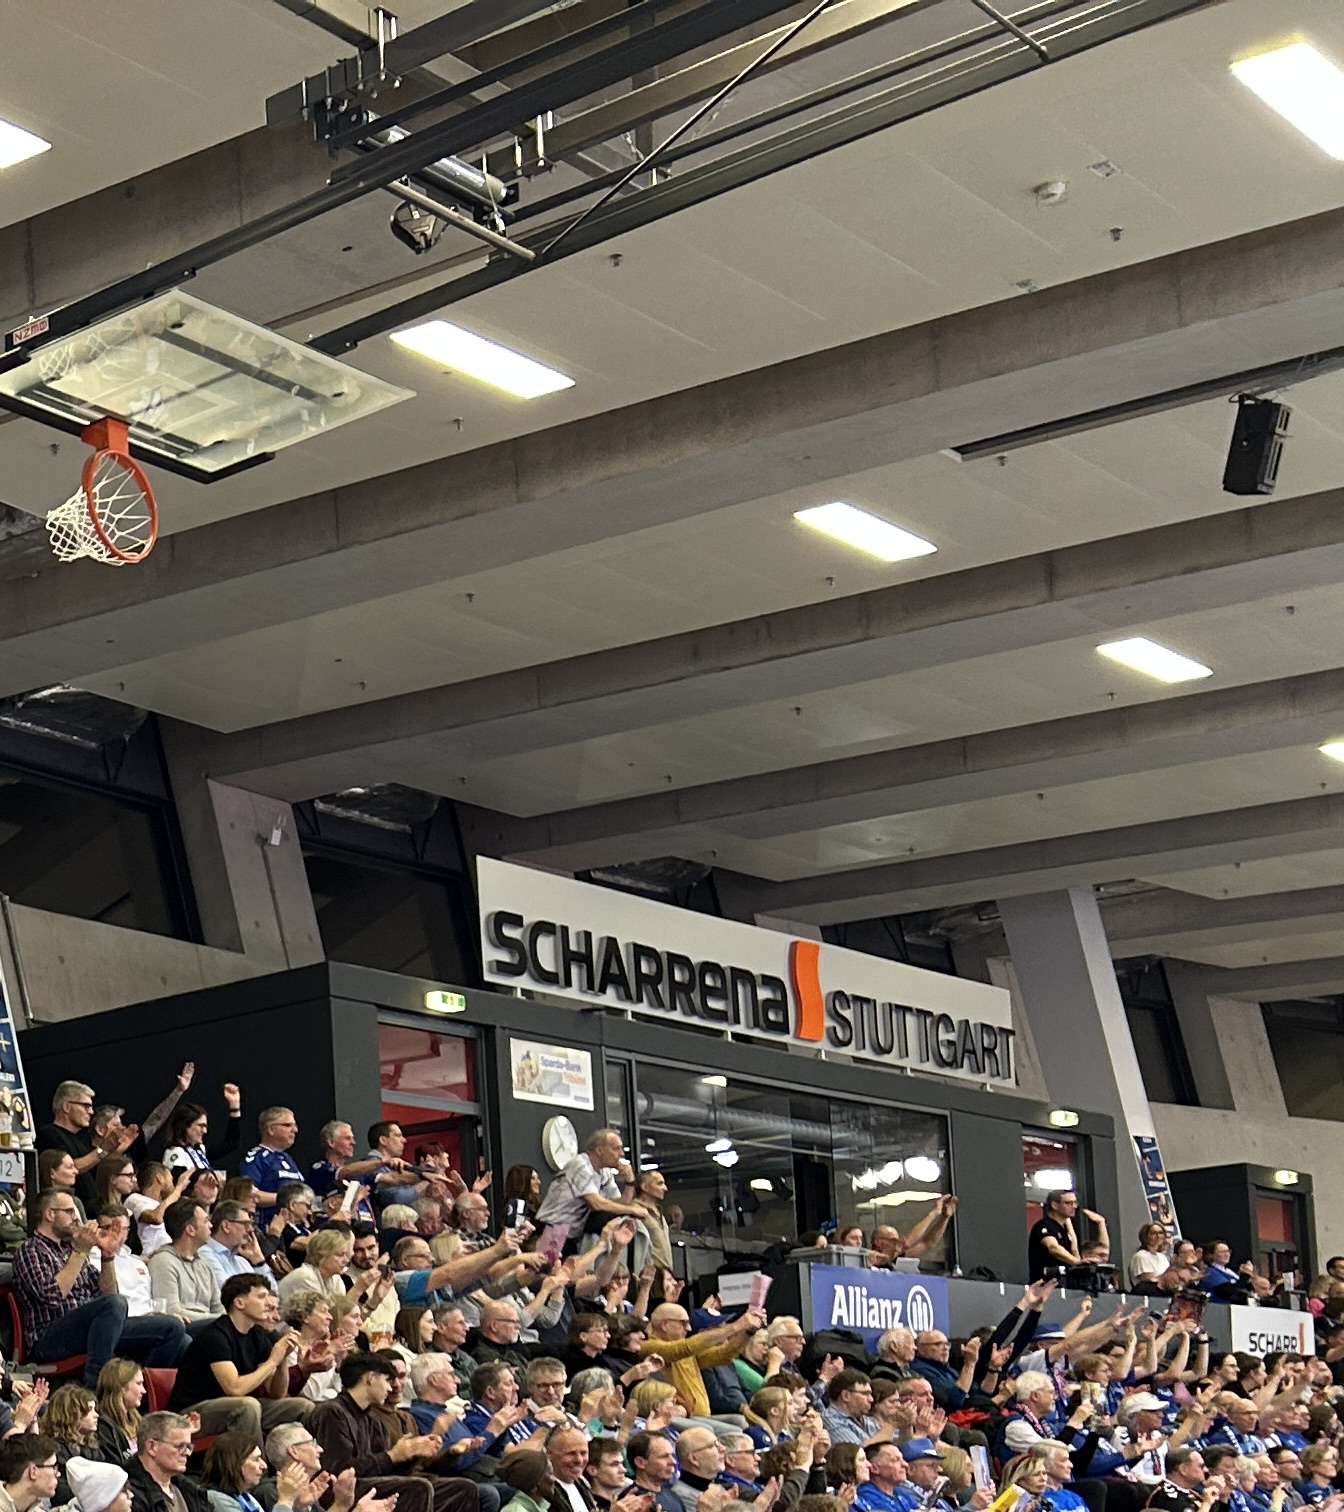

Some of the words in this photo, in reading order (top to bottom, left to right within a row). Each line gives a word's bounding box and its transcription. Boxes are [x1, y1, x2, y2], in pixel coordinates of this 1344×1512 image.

[826, 990, 1016, 1084] STUTTGART
[0, 1159, 14, 1176] 12
[831, 1285, 904, 1329] Allianz
[1249, 1332, 1298, 1352] SCHARR
